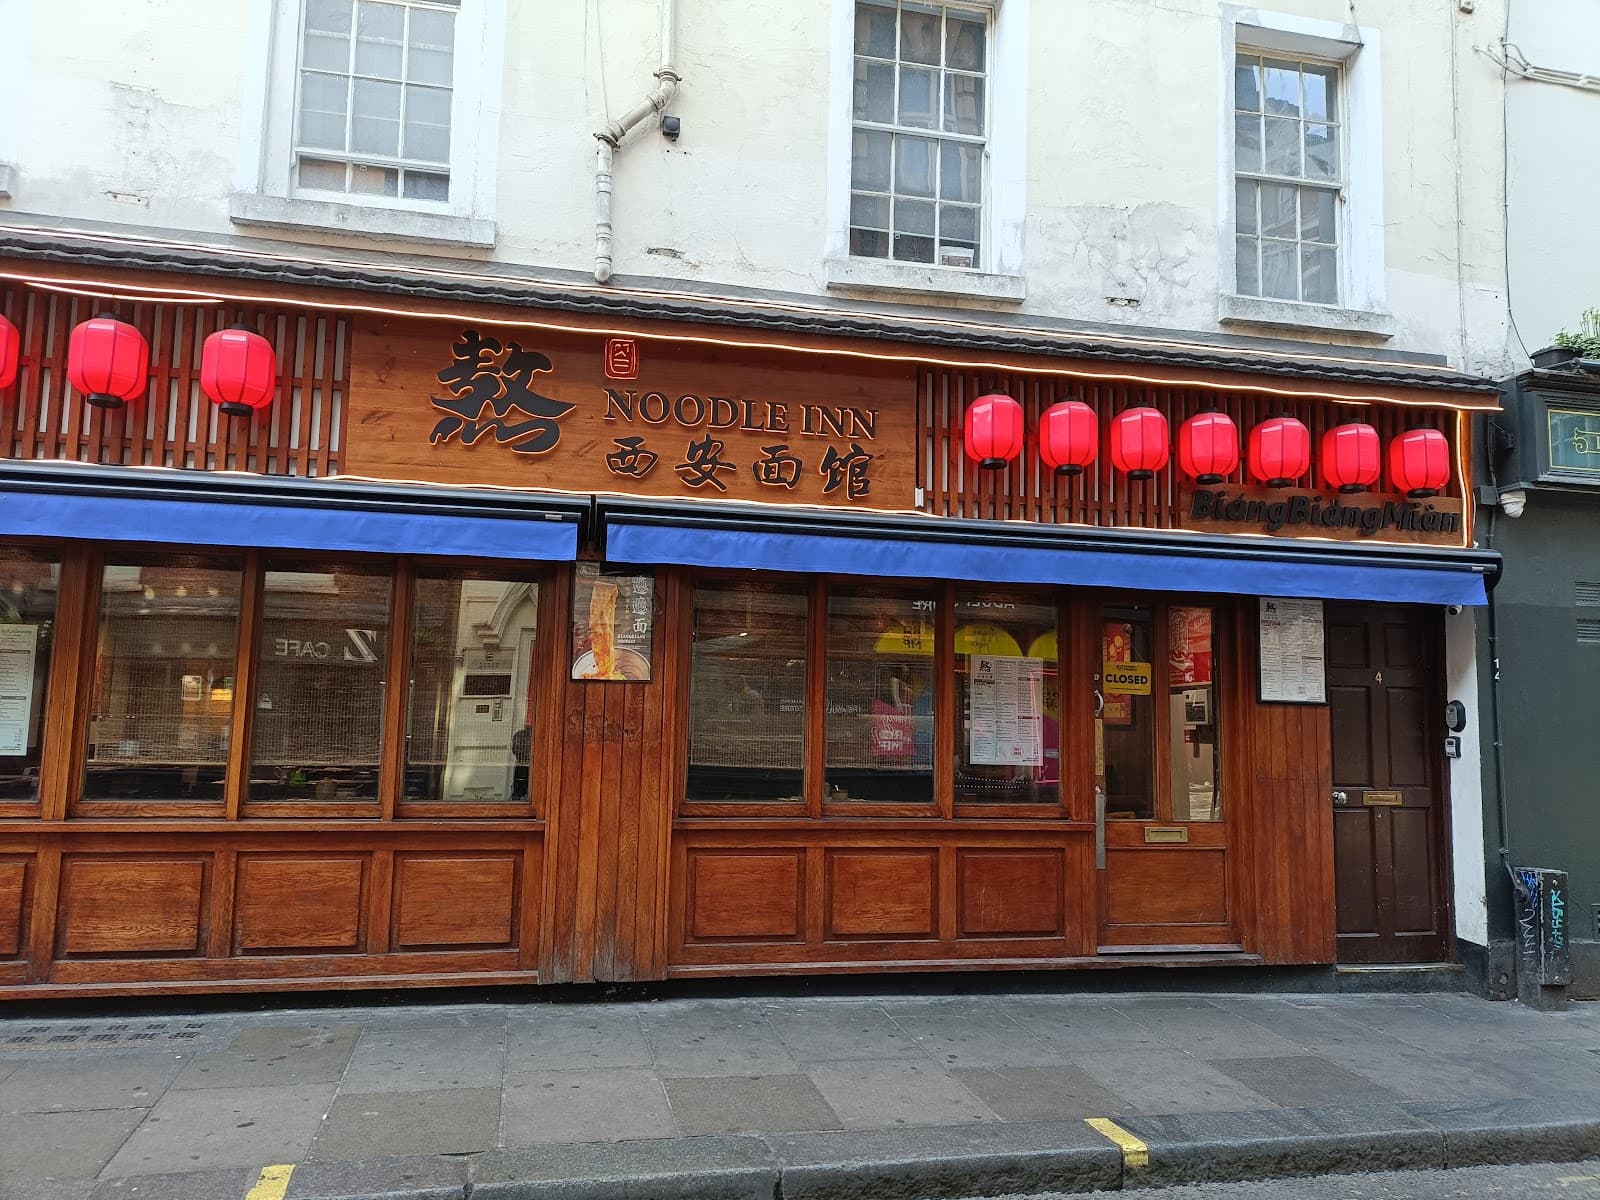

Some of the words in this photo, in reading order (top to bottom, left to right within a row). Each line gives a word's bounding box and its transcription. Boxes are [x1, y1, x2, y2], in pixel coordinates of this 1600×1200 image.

[602, 387, 790, 434] NOODLE
[800, 403, 880, 440] INN
[604, 433, 875, 501] 西安面馆
[1105, 673, 1148, 685] CLOSED
[1375, 672, 1383, 684] 4
